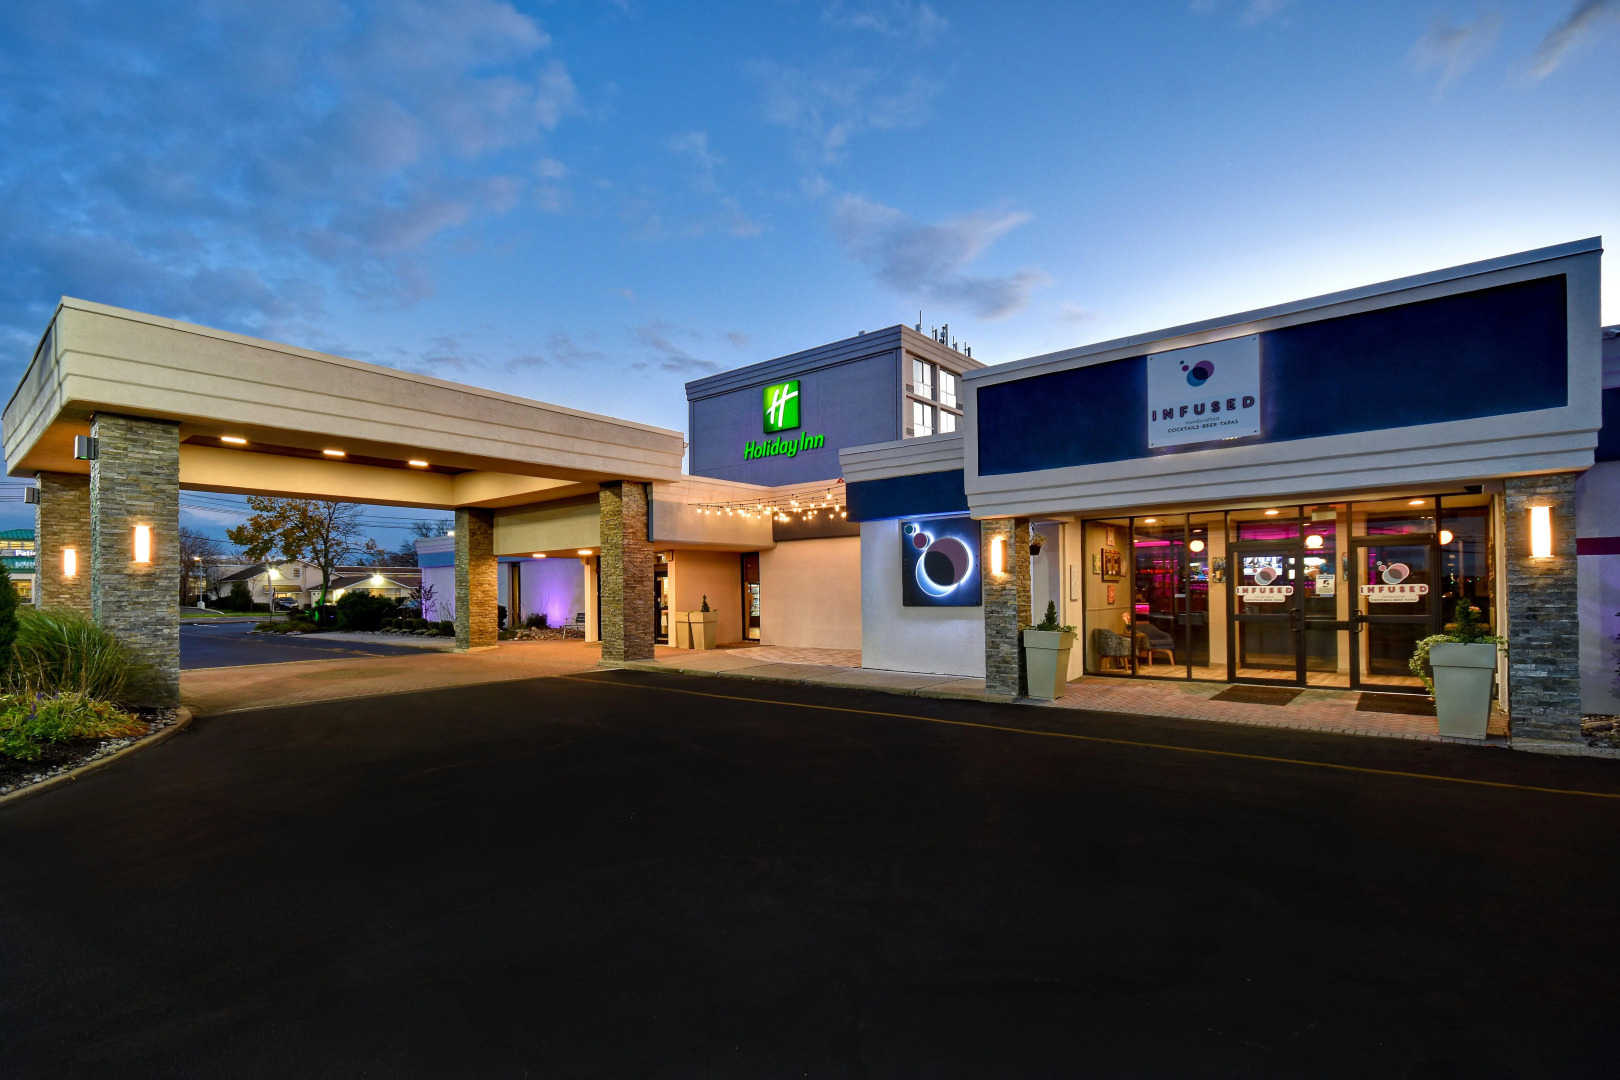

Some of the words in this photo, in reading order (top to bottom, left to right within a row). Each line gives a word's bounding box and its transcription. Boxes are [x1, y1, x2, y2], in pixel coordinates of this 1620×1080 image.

[1152, 396, 1255, 421] INFUSED
[1185, 416, 1220, 425] Handcrafted
[744, 436, 799, 460] Holiday
[799, 431, 825, 451] Inn
[1236, 586, 1293, 594] INFUSED
[1360, 585, 1428, 594] INFUSED
